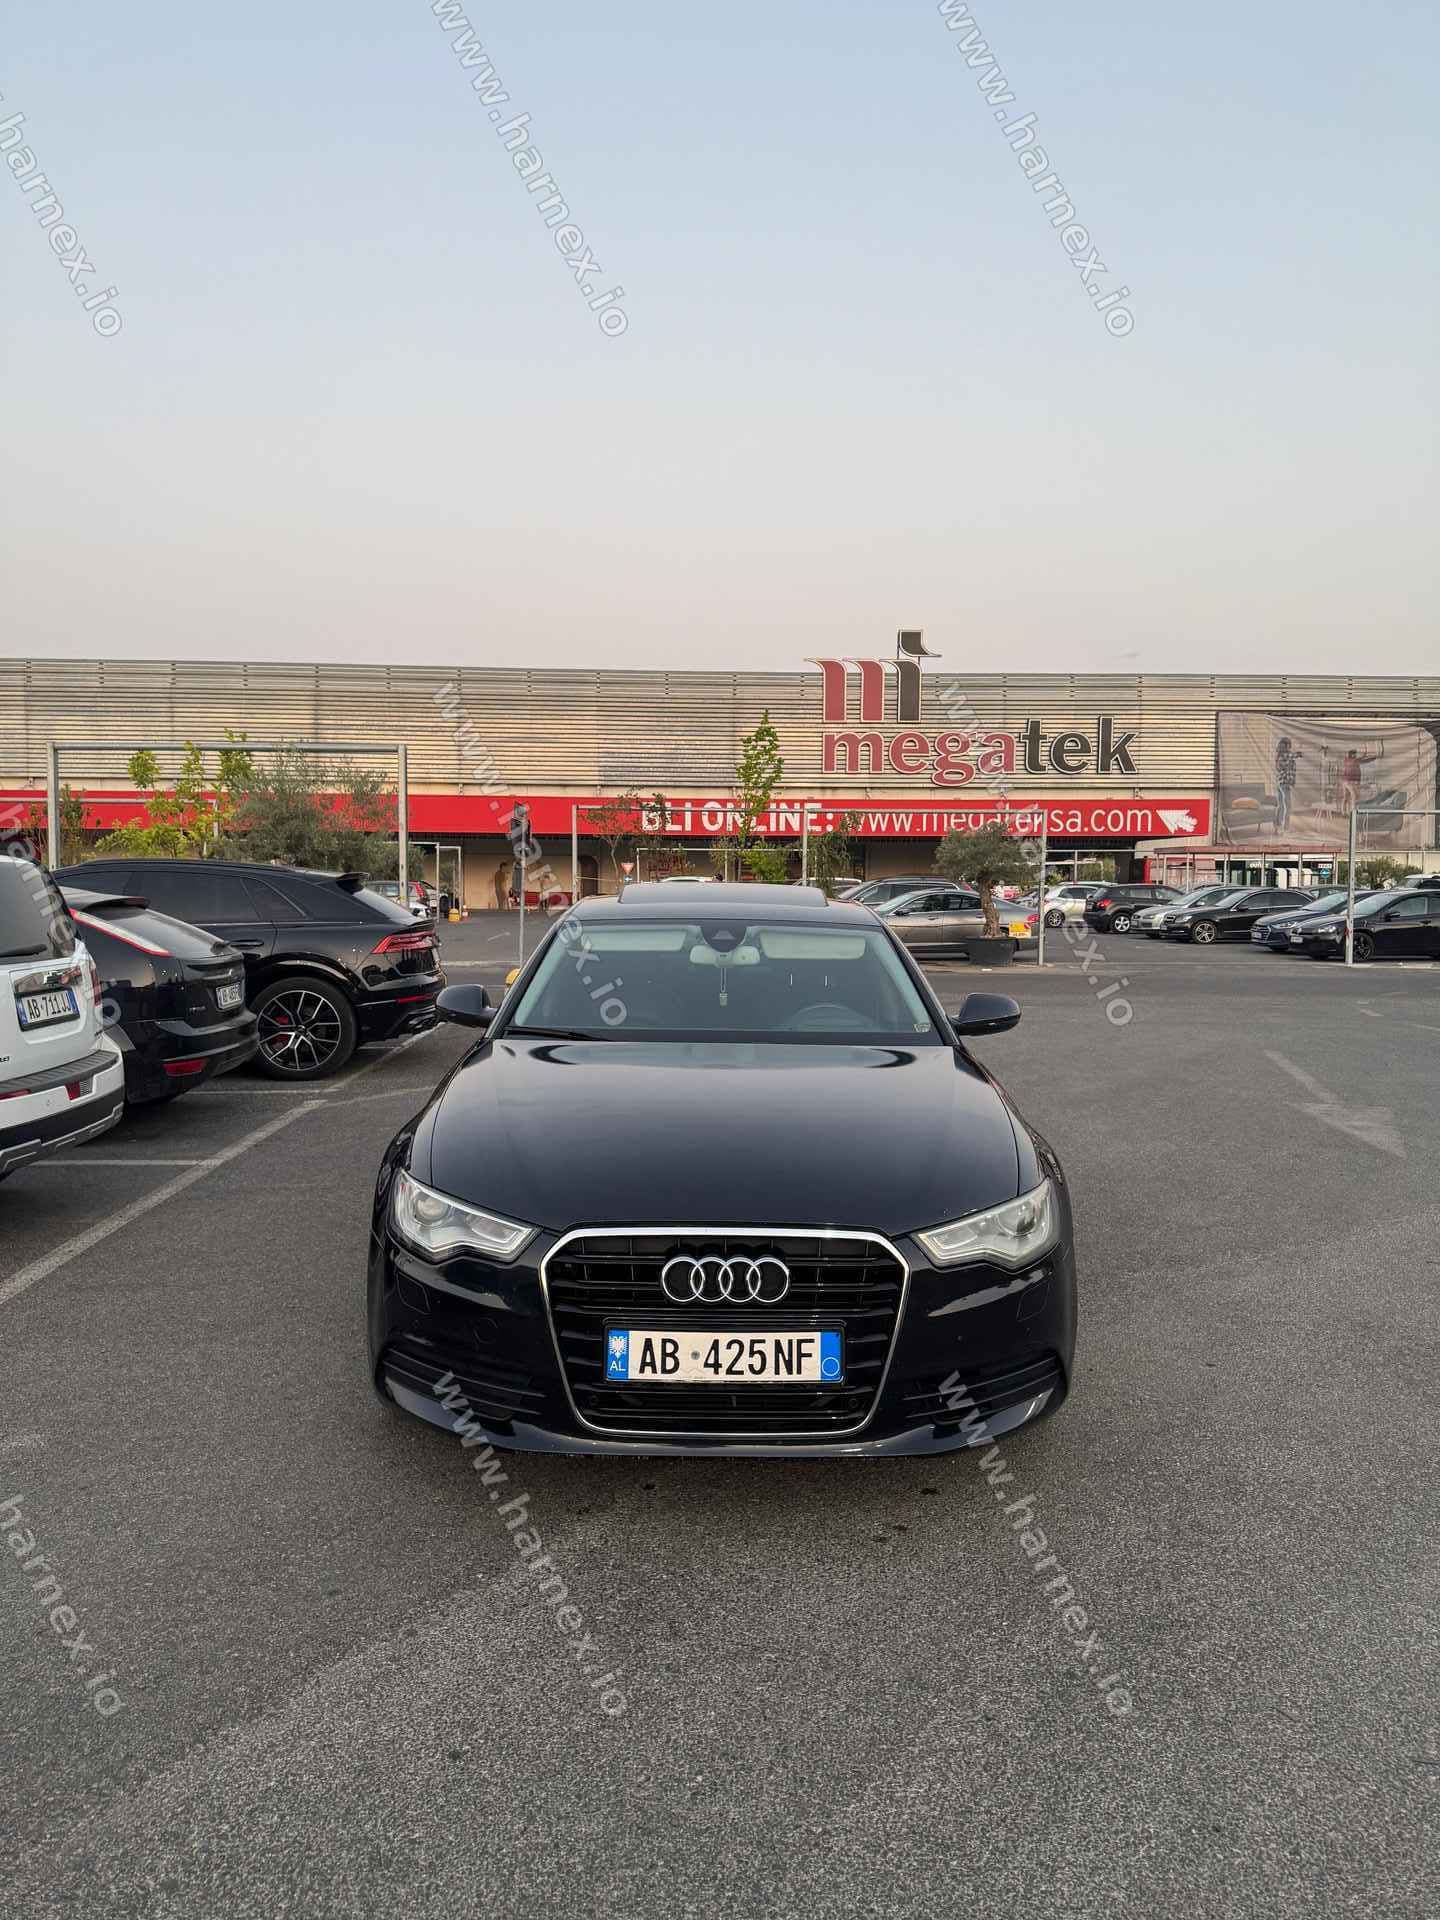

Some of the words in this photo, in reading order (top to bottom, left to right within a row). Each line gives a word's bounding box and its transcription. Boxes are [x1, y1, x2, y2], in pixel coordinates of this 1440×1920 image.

[821, 716, 1140, 787] megatek
[609, 1360, 626, 1372] AL
[638, 1337, 680, 1375] AB
